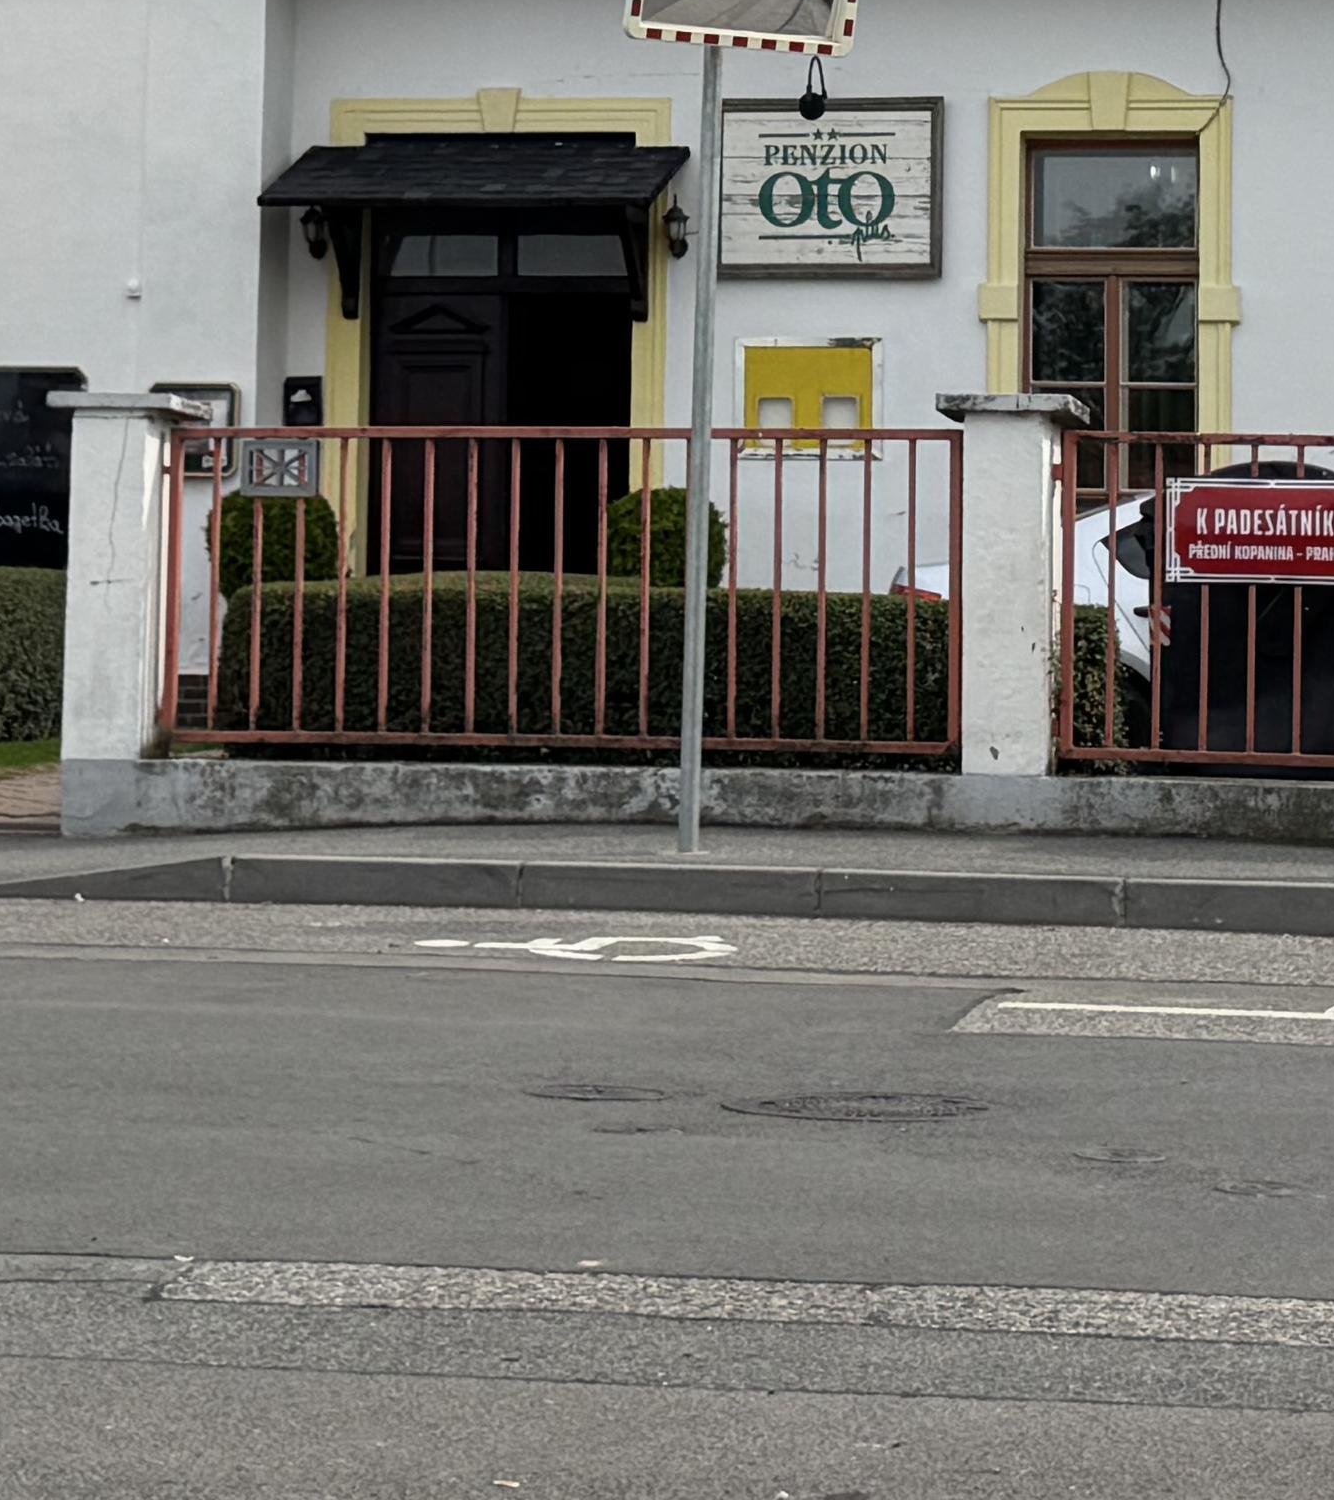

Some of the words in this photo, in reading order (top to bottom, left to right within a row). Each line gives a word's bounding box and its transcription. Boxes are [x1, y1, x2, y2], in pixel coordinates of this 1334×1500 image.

[763, 143, 888, 166] PENZION
[1197, 508, 1208, 535] K
[1188, 540, 1231, 560] PŘEDNÍ
[1234, 545, 1294, 561] KOPANINA
